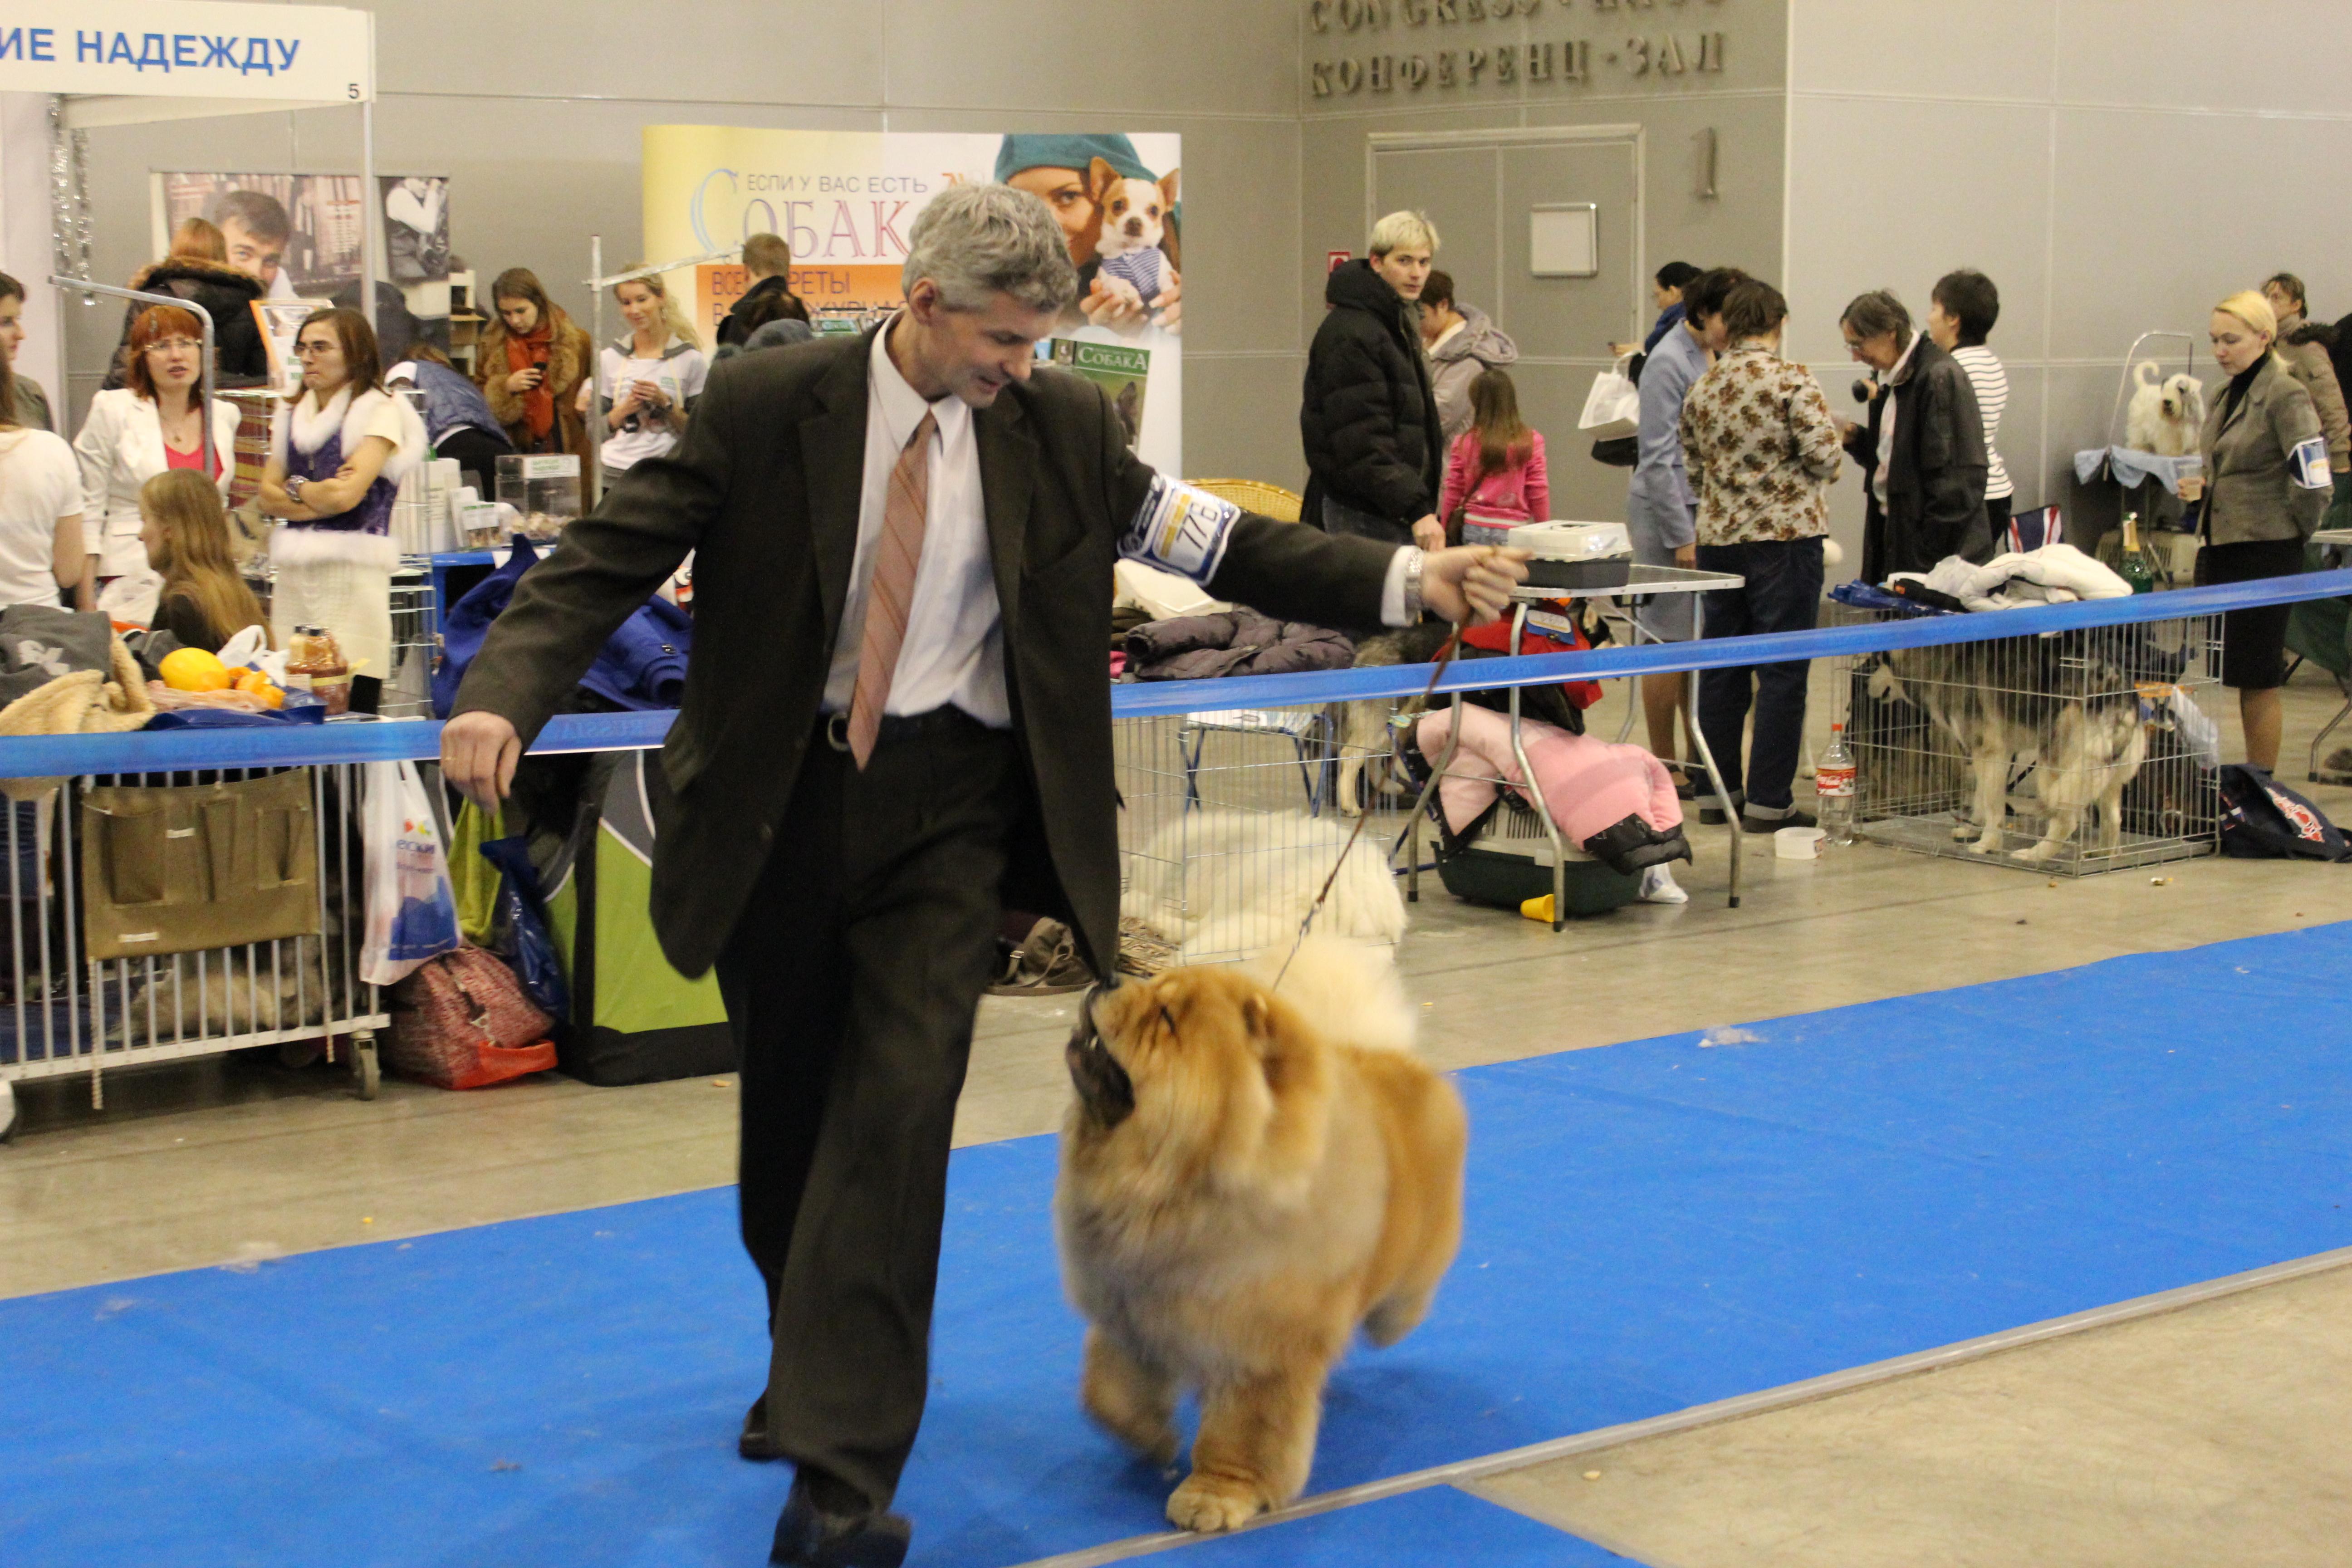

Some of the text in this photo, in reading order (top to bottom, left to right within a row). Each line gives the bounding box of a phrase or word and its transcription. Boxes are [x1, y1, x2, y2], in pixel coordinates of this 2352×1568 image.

[0, 26, 300, 76] ИЕ НАДЕЖДУ
[348, 83, 359, 99] 5
[747, 174, 929, 193] ЕСЛИ У ВАС ЕСТЬ
[690, 168, 965, 262] СОБАК
[712, 271, 850, 295] ВСЕ РЕТЫ
[1078, 346, 1148, 370] СОБАКА
[1176, 501, 1219, 550] 776
